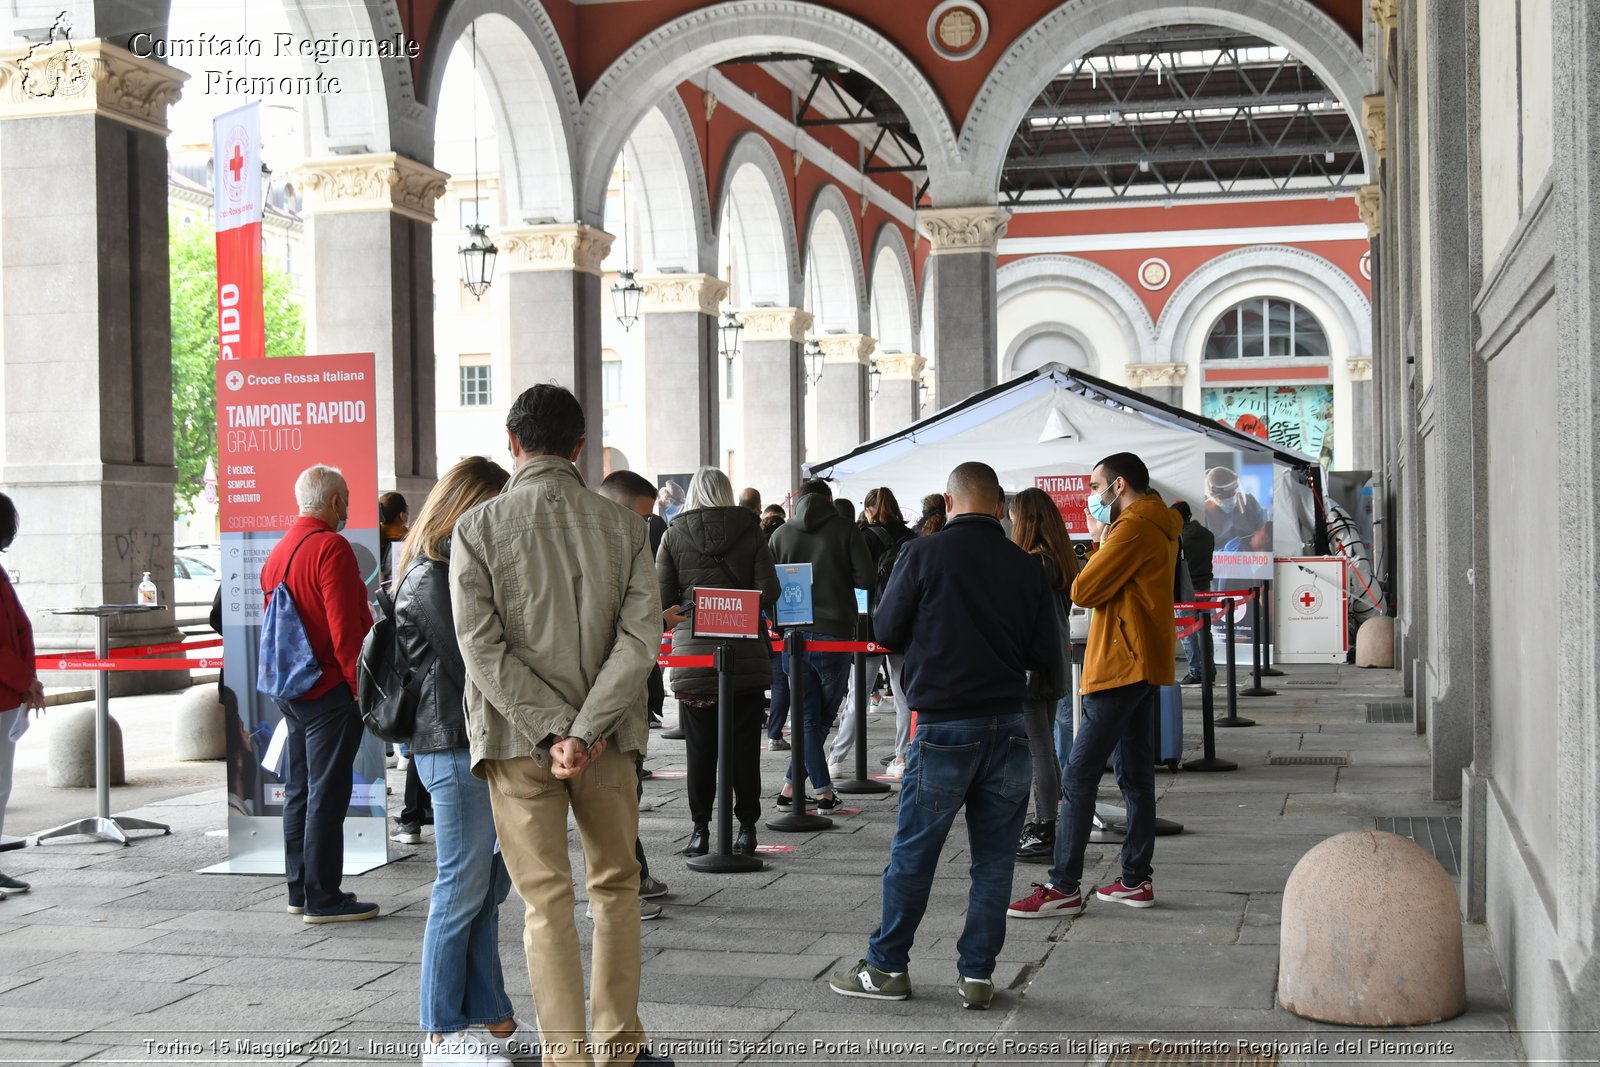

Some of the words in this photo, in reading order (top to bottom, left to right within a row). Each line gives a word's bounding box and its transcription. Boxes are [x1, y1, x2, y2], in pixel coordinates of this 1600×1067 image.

[247, 374, 281, 386] Croce
[284, 373, 320, 384] Rossa
[323, 371, 365, 382] Italiana
[226, 404, 302, 427] TAMPONE
[306, 400, 366, 425] RAPIDO
[227, 428, 302, 453] GRATUITO
[227, 479, 256, 489] SEMPLICE
[1037, 477, 1084, 492] ENTRATA
[233, 493, 261, 503] GRATUITO
[229, 516, 255, 529] SCOPRI
[256, 515, 278, 528] COME
[1212, 554, 1242, 566] AMPONE
[1243, 554, 1268, 566] RAPIDO
[698, 596, 743, 611] ENTRATA
[697, 611, 749, 628] ENTRANCE
